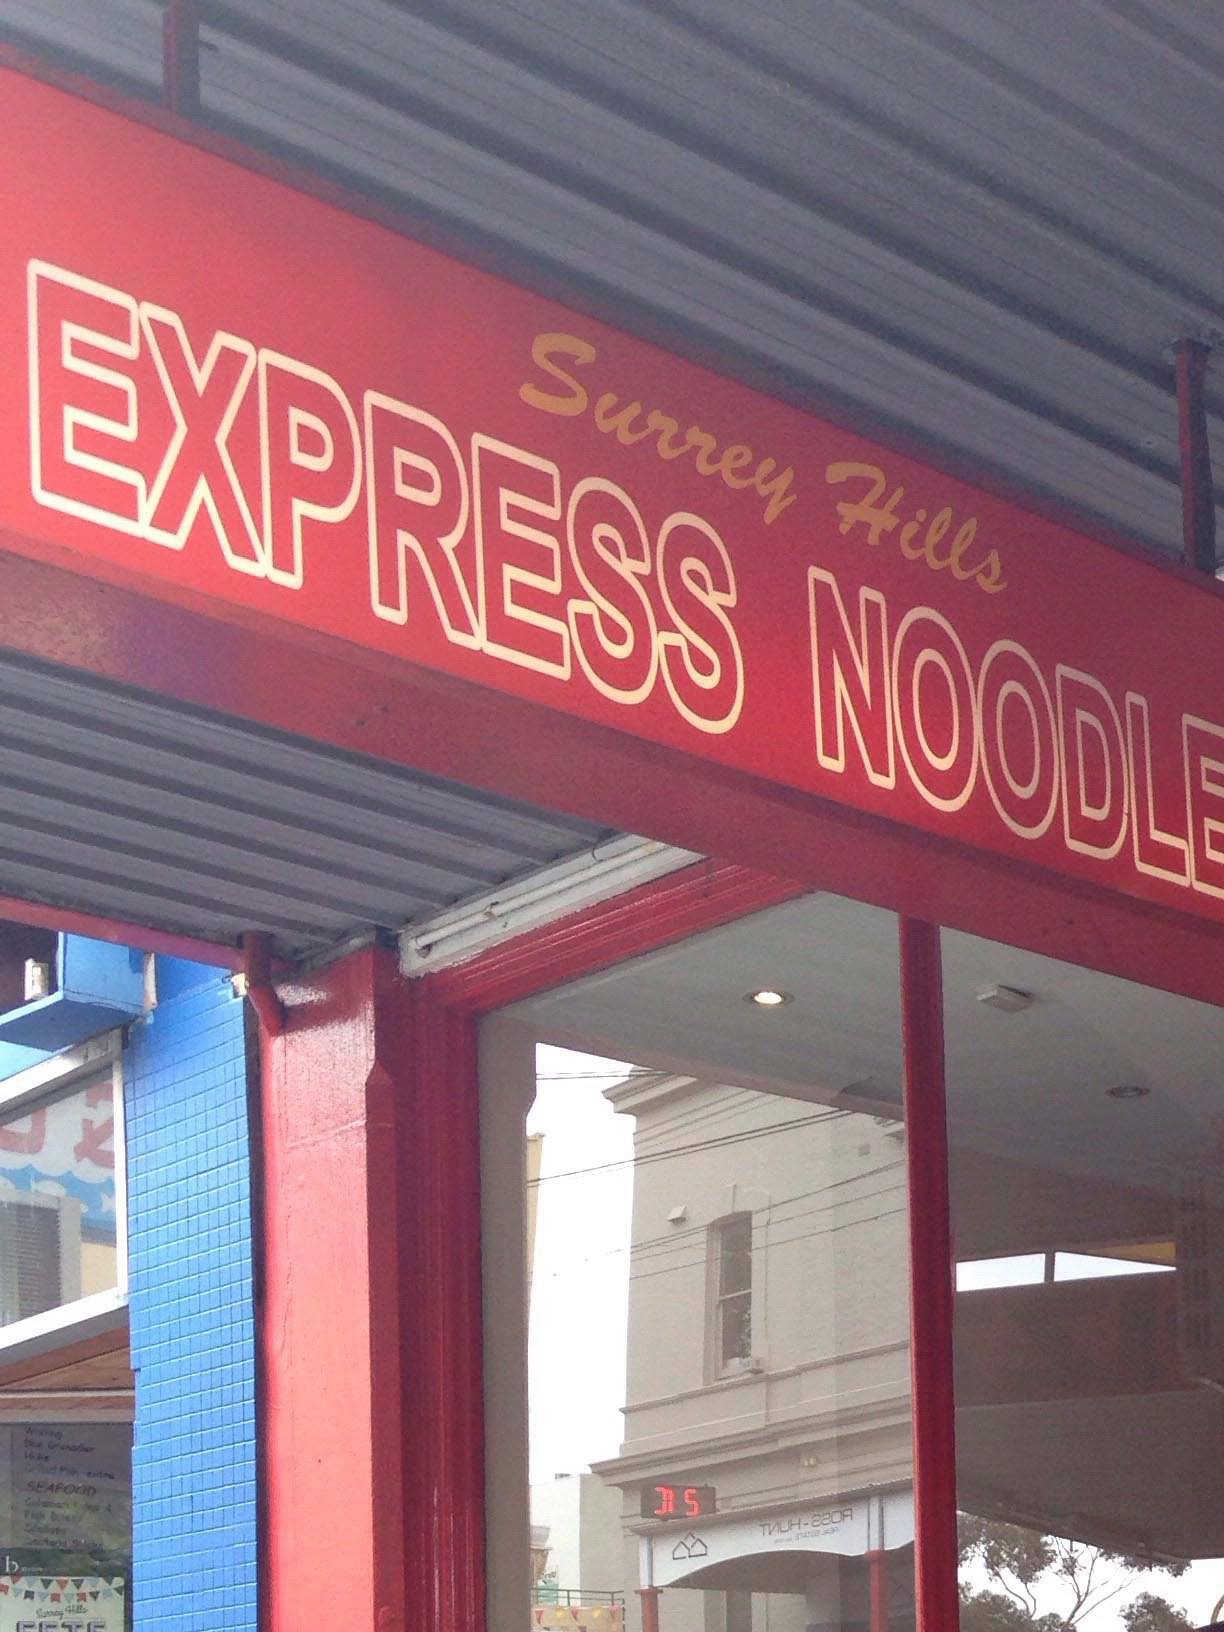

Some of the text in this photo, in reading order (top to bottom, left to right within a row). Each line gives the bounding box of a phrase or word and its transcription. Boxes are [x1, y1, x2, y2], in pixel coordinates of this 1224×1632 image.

[27, 258, 746, 735] EXPRESS
[519, 332, 1008, 594] Surrey Hills
[26, 1480, 97, 1496] SEAFOOD
